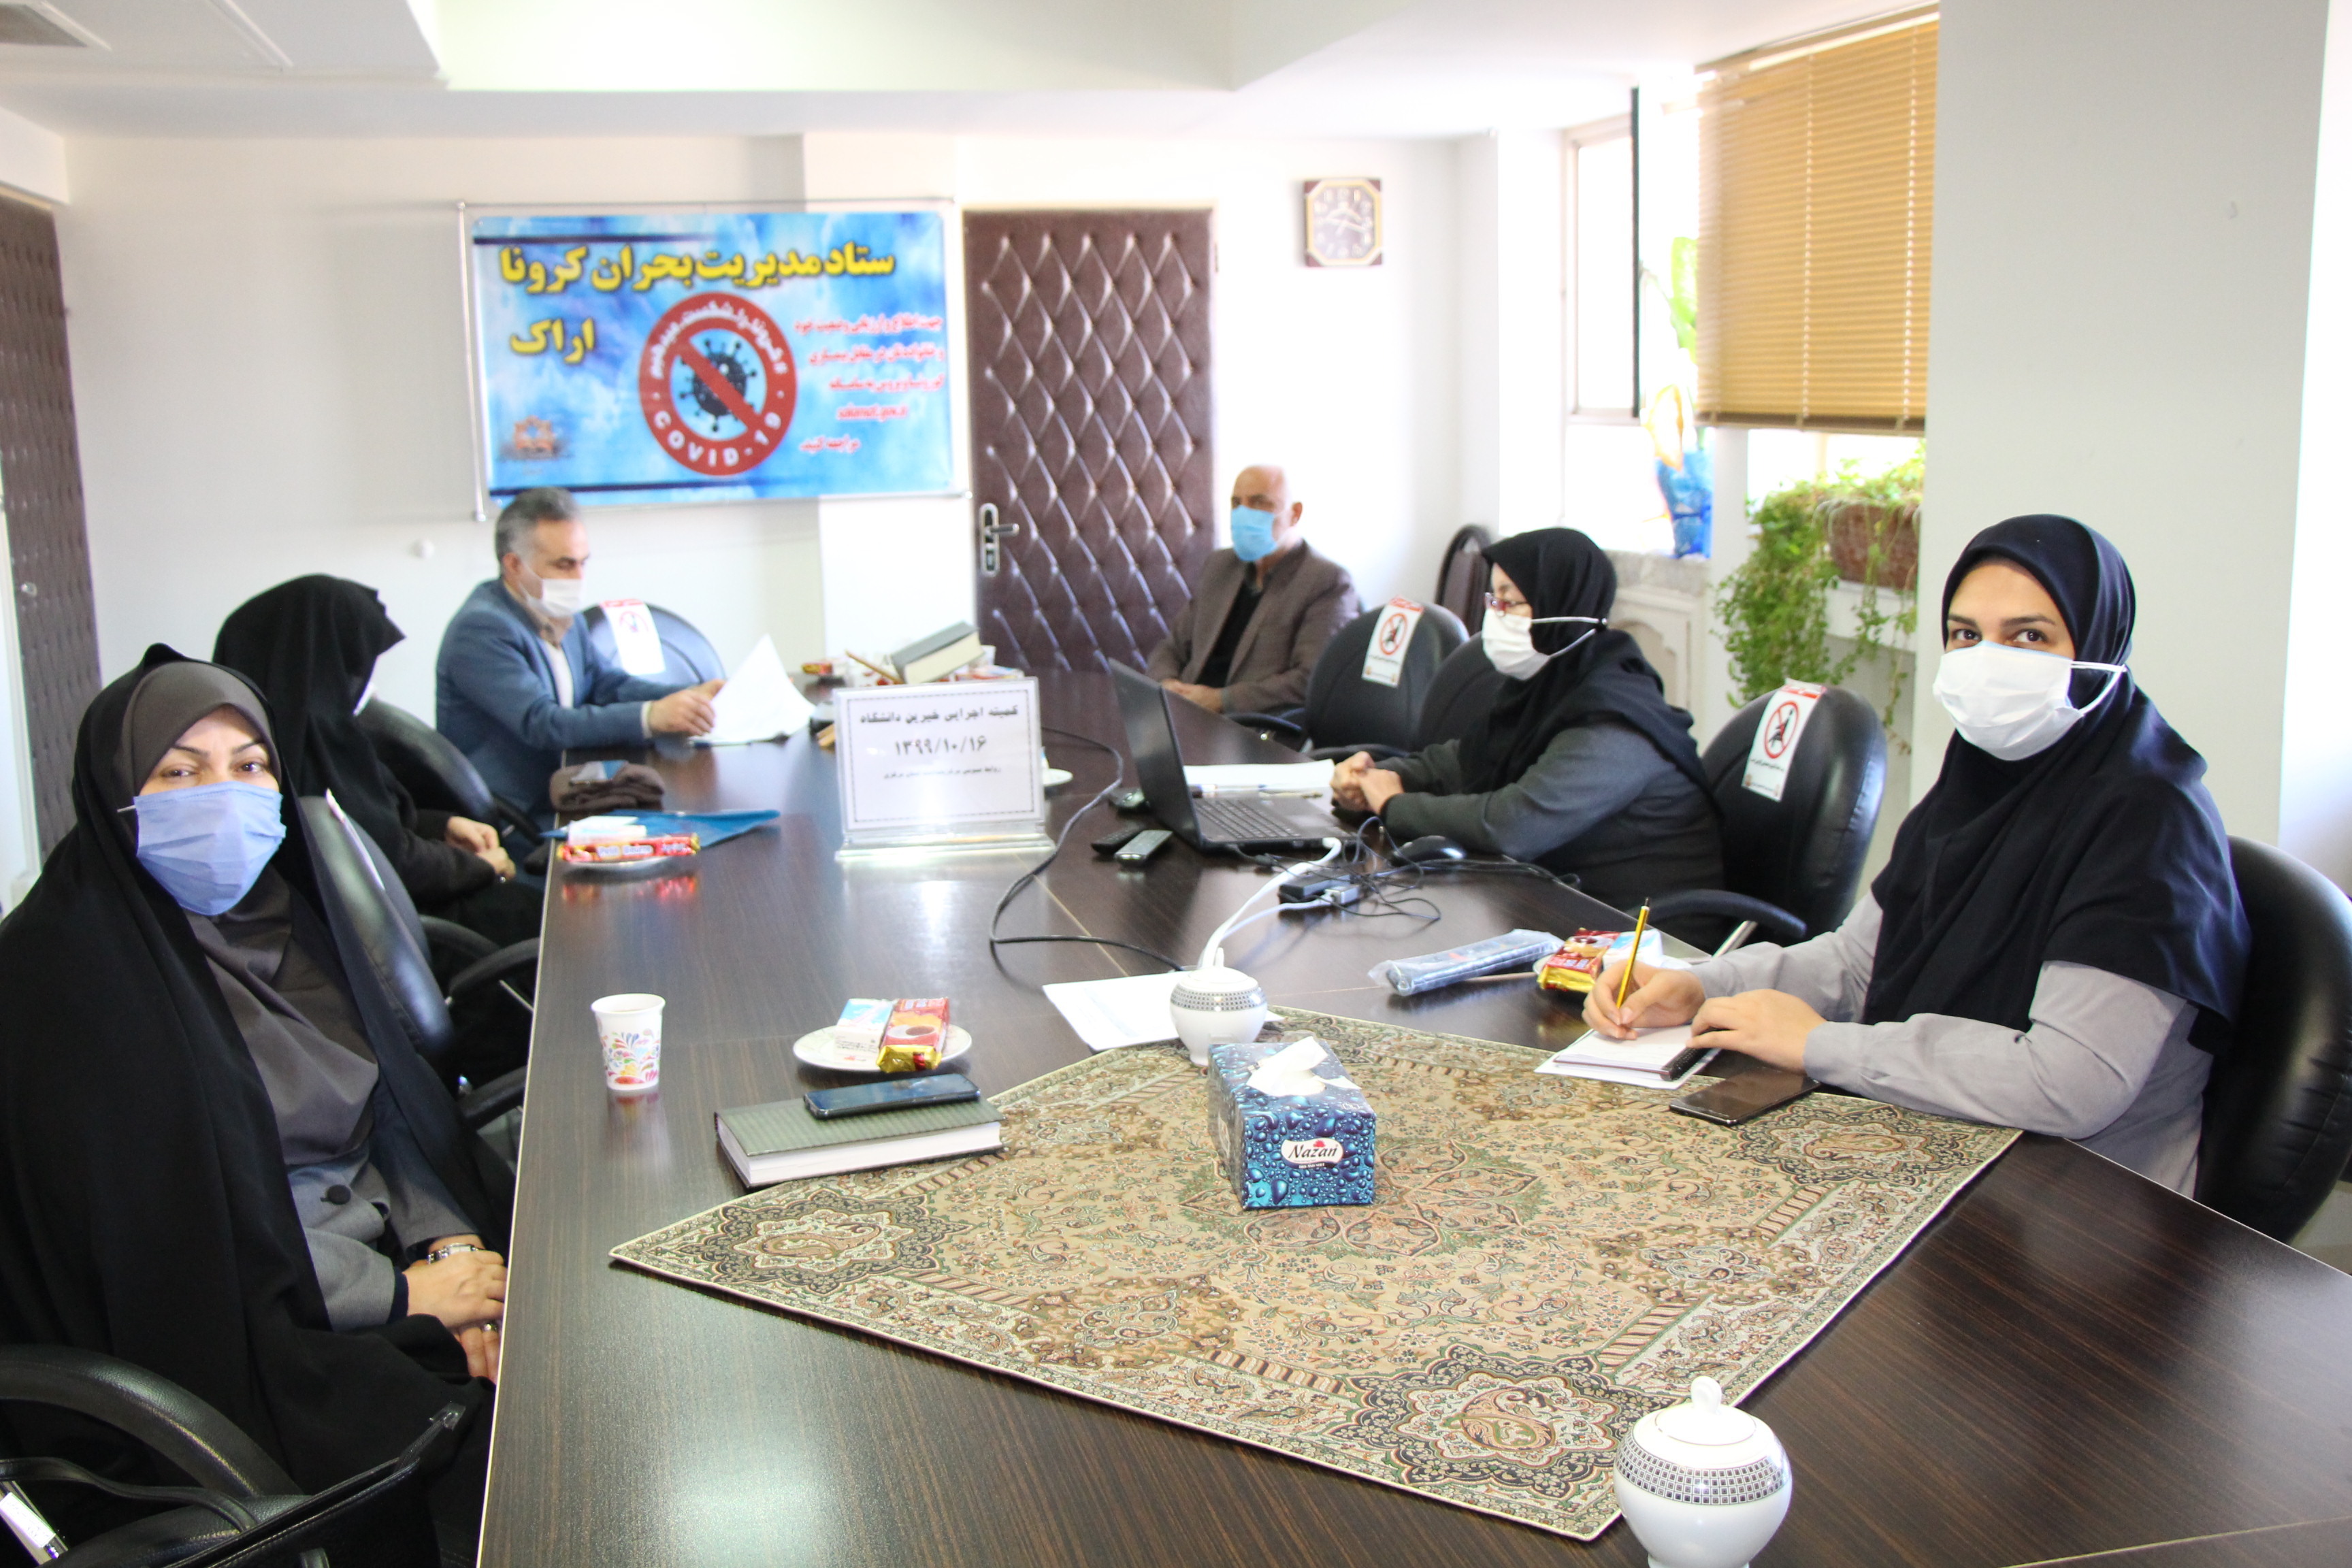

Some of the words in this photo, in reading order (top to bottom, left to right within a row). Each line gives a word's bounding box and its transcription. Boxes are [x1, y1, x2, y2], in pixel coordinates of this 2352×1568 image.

[500, 246, 587, 293] کرونا
[591, 245, 693, 291] بحران
[695, 248, 822, 288] مدیریت
[823, 241, 895, 275] ستاد
[510, 318, 595, 363] اراک
[653, 410, 782, 468] COVID-19
[860, 712, 901, 723] دانشگاه
[905, 709, 939, 724] خیرین
[945, 706, 984, 722] اجرایی
[988, 705, 1018, 719] کمیته
[1288, 1143, 1338, 1158] Nazan
